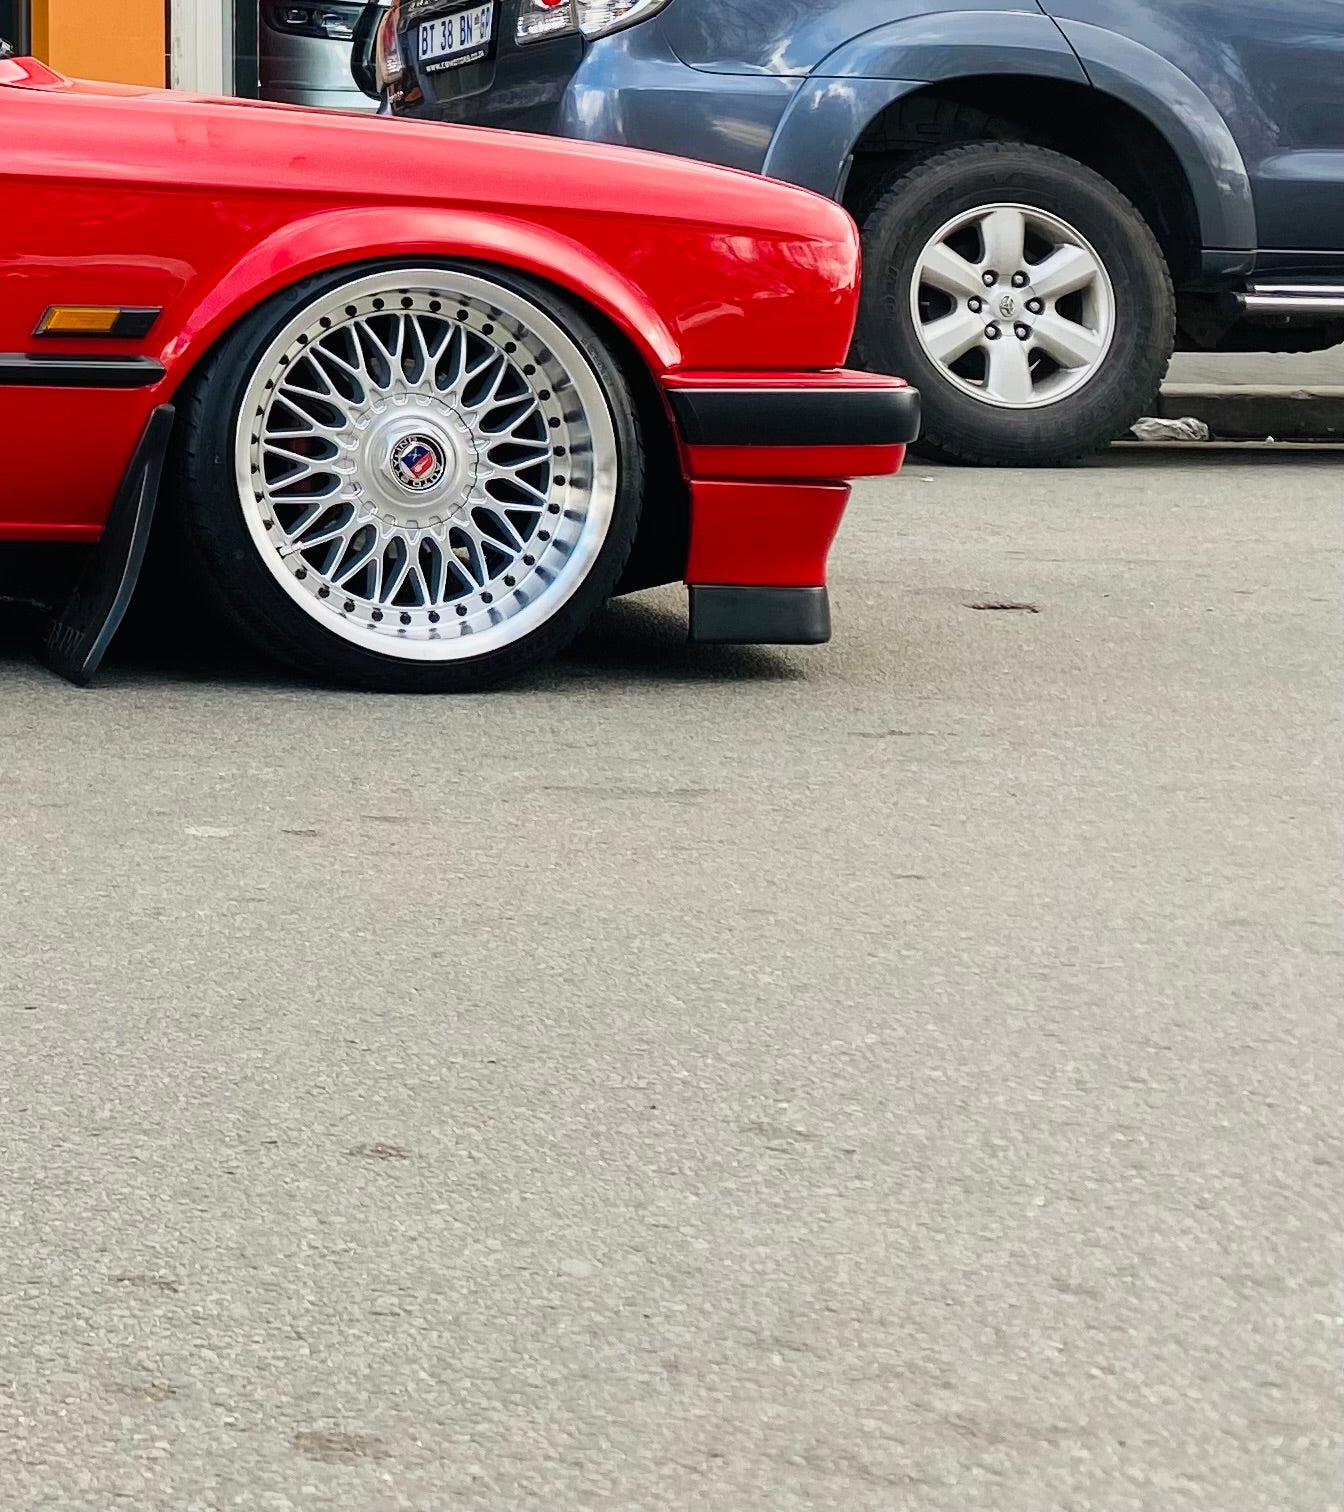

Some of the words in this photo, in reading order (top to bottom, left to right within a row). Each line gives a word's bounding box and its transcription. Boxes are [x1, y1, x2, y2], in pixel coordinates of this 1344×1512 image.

[422, 25, 435, 55] BT
[441, 20, 453, 50] 38
[460, 15, 472, 45] BN
